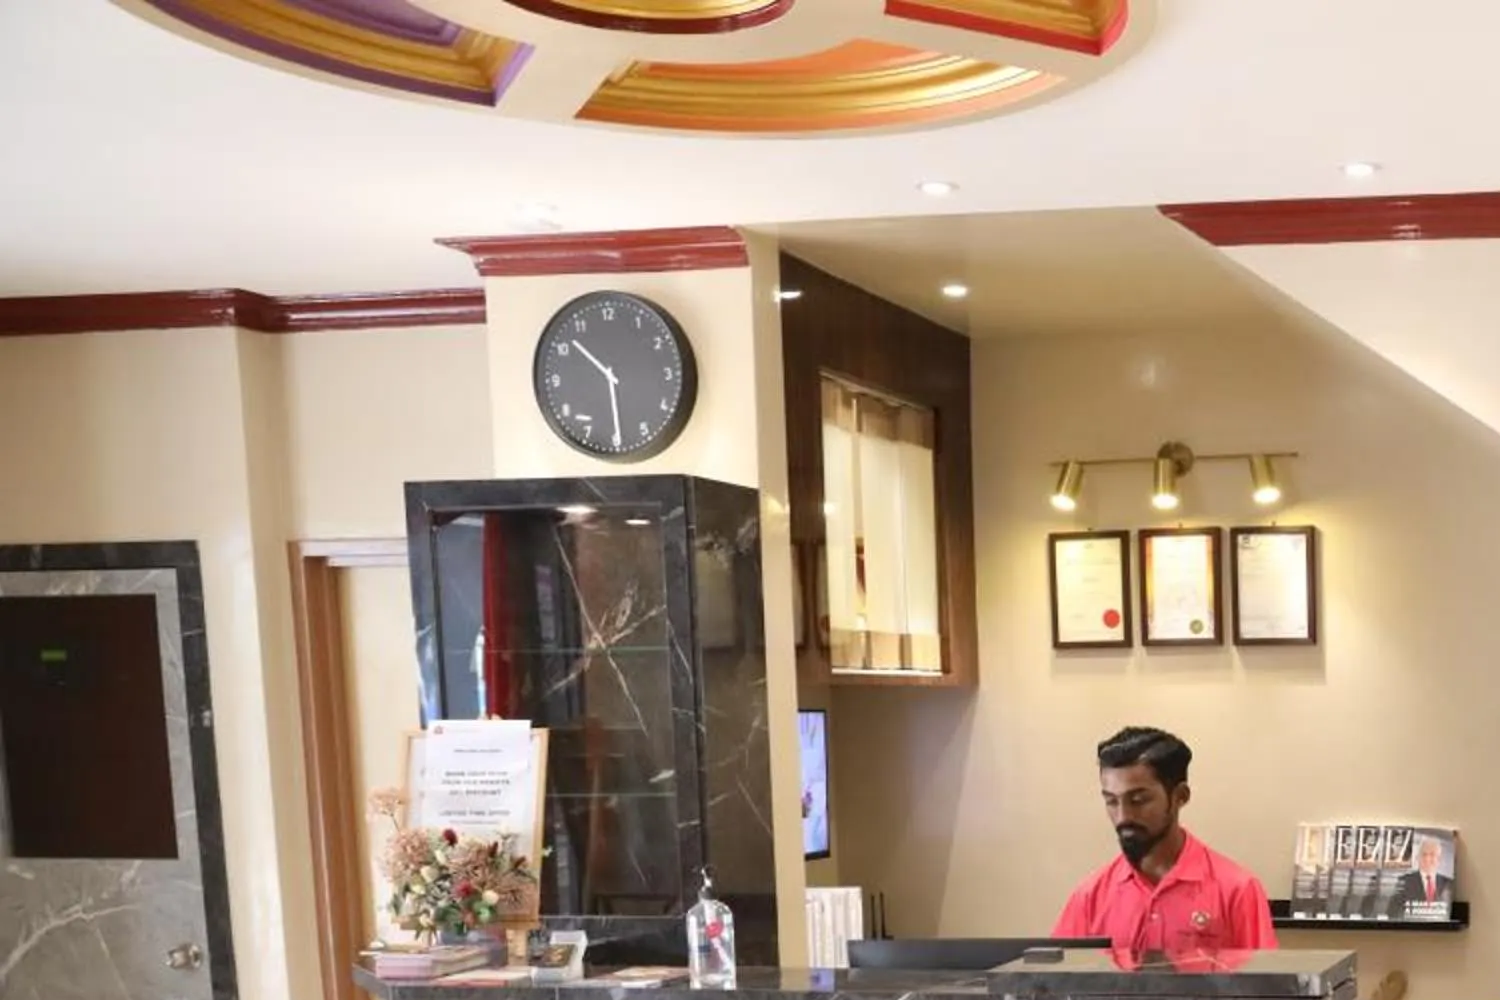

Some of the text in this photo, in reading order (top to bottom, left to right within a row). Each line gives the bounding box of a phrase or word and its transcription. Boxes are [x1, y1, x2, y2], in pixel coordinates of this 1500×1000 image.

[601, 307, 614, 320] 12
[575, 319, 586, 333] 11
[635, 316, 641, 329] 1
[557, 342, 569, 356] 10
[653, 336, 662, 350] 2
[551, 373, 561, 388] 9
[663, 366, 673, 381] 3
[583, 427, 592, 438] 7
[639, 422, 649, 436] 5
